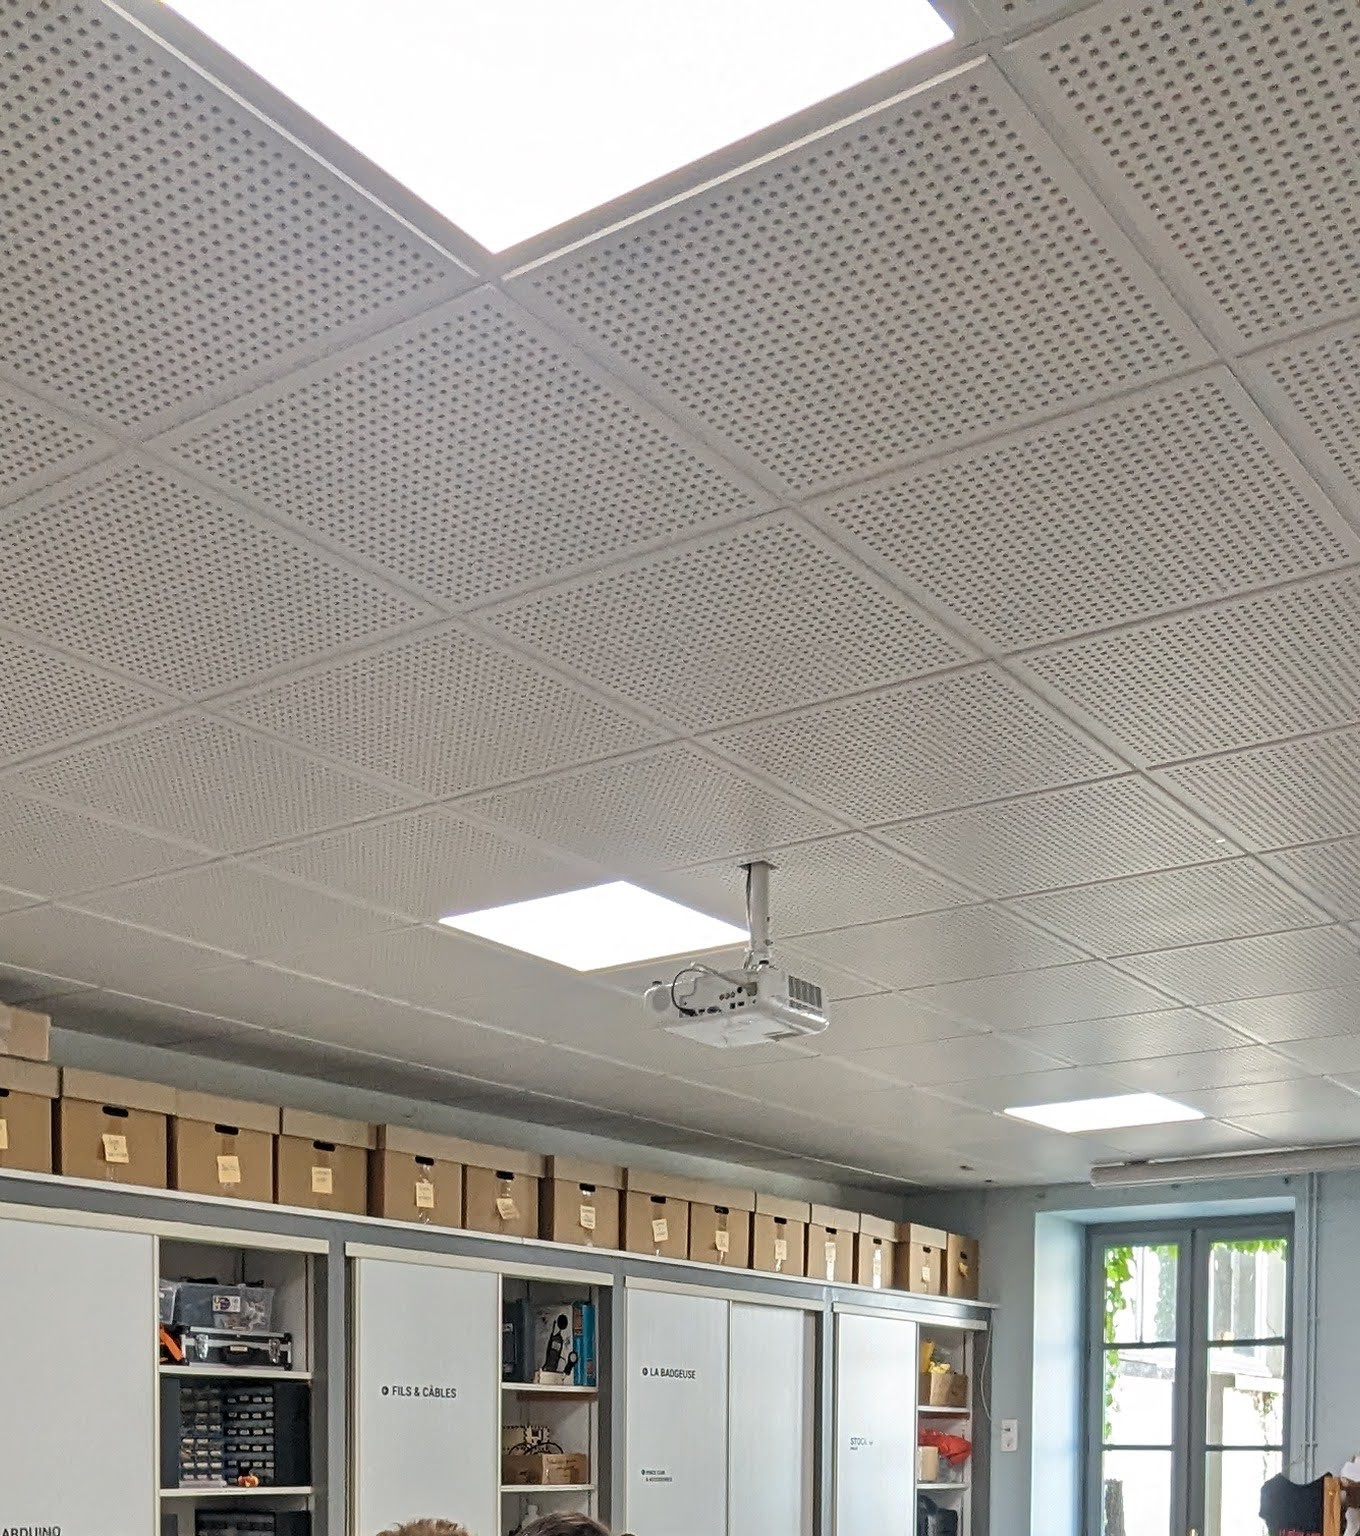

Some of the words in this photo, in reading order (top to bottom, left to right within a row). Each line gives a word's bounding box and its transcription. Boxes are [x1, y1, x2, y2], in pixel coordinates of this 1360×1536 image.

[650, 1368, 659, 1377] LA
[660, 1368, 696, 1380] BADGEUSE
[392, 1386, 412, 1397] FILS
[413, 1386, 420, 1397] &
